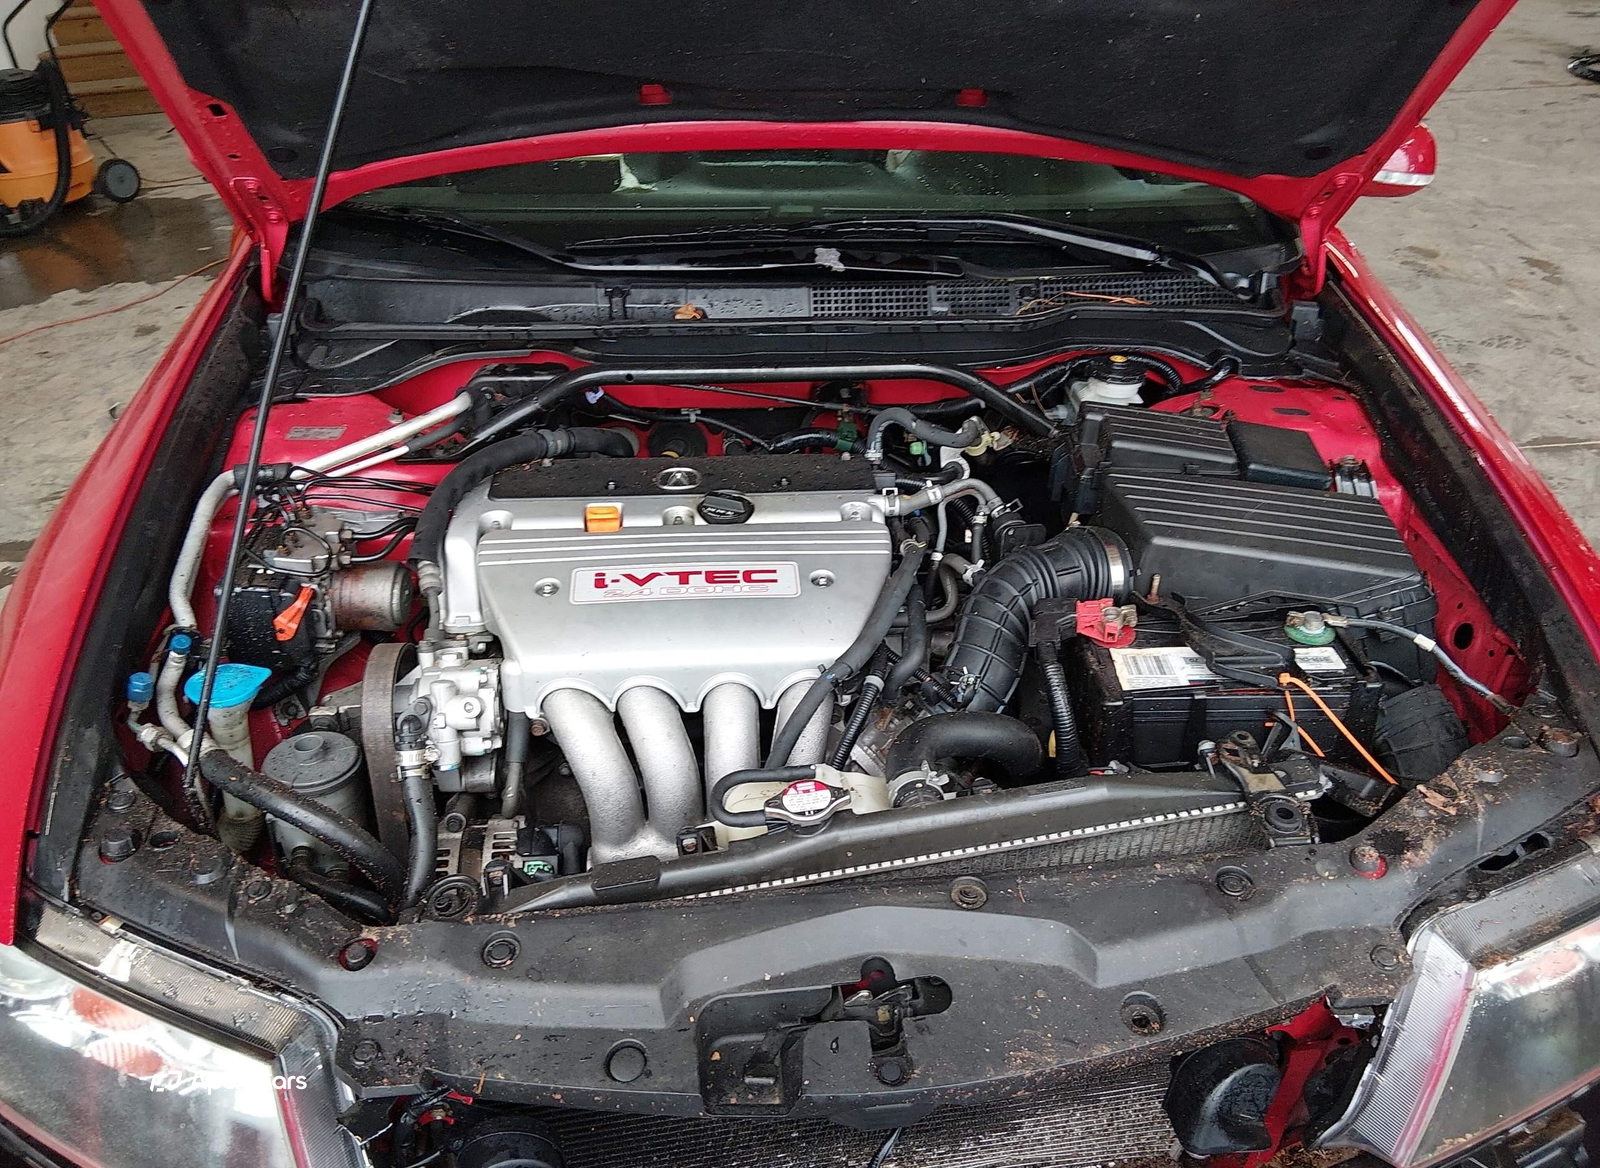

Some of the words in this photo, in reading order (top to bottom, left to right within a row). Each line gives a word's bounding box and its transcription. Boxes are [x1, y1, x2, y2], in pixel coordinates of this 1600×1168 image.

[594, 569, 778, 588] i-VTEC
[603, 587, 653, 598] 2.4
[660, 584, 769, 595] DOHC
